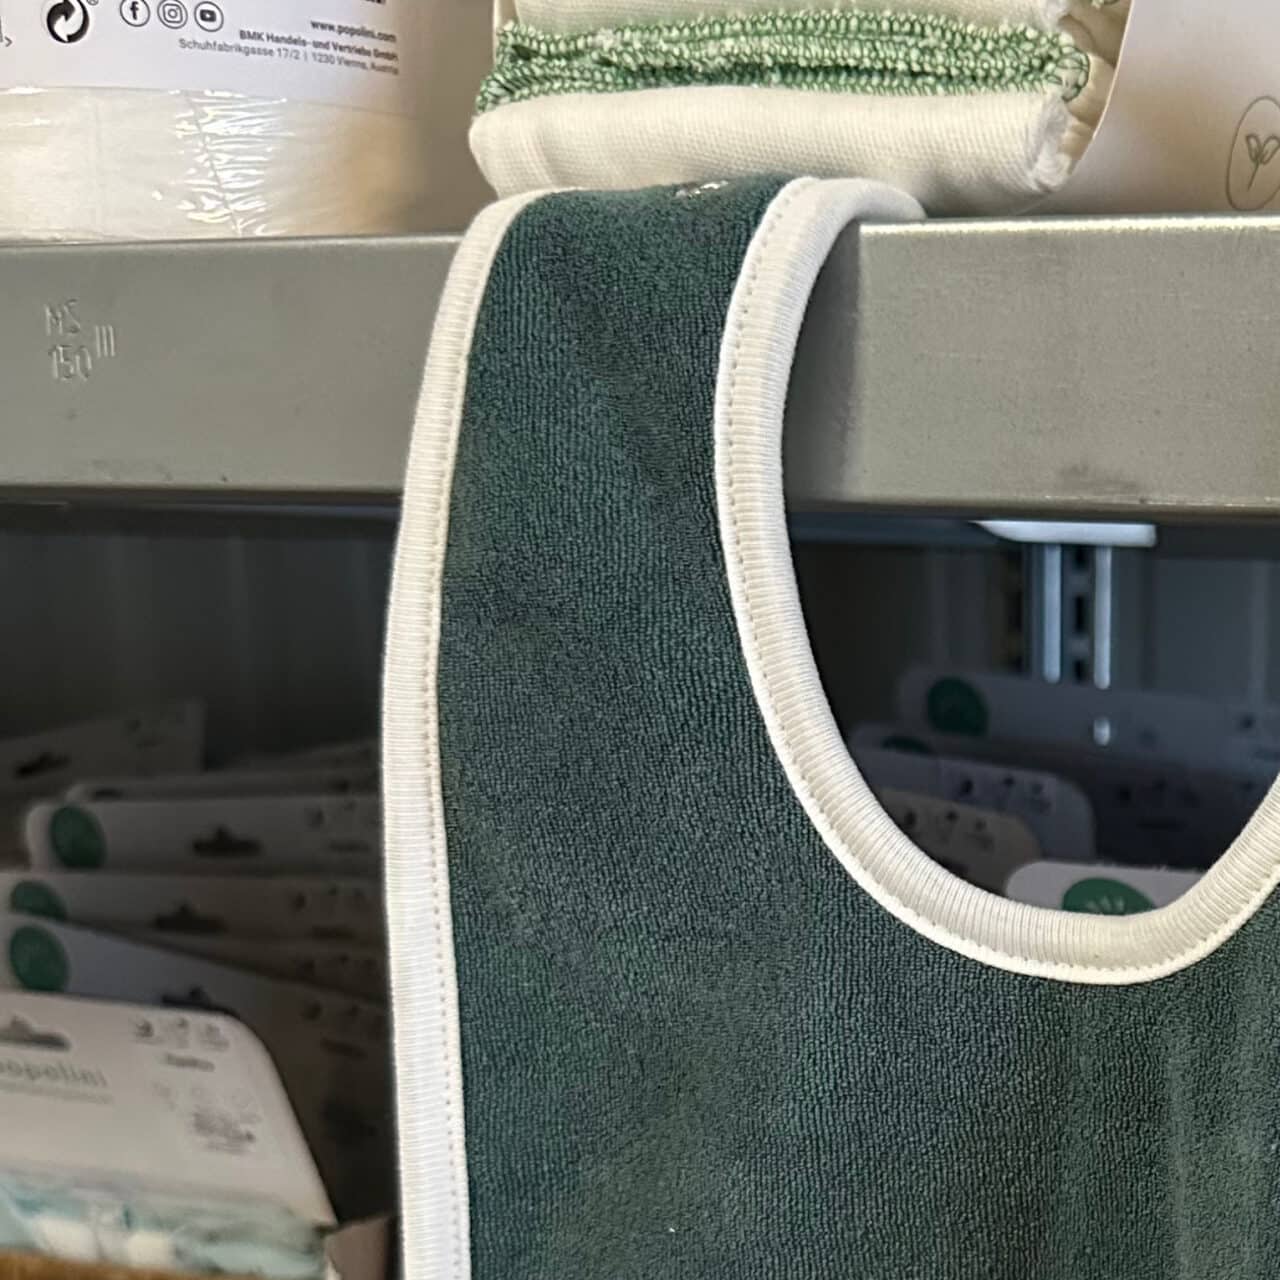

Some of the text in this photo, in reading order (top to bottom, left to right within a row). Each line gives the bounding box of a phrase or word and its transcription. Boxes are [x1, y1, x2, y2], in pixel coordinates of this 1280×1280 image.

[239, 29, 264, 42] BMK
[178, 38, 275, 57] Schuhfabrikgasse
[277, 48, 301, 60] 17/2
[312, 53, 336, 65] 1230
